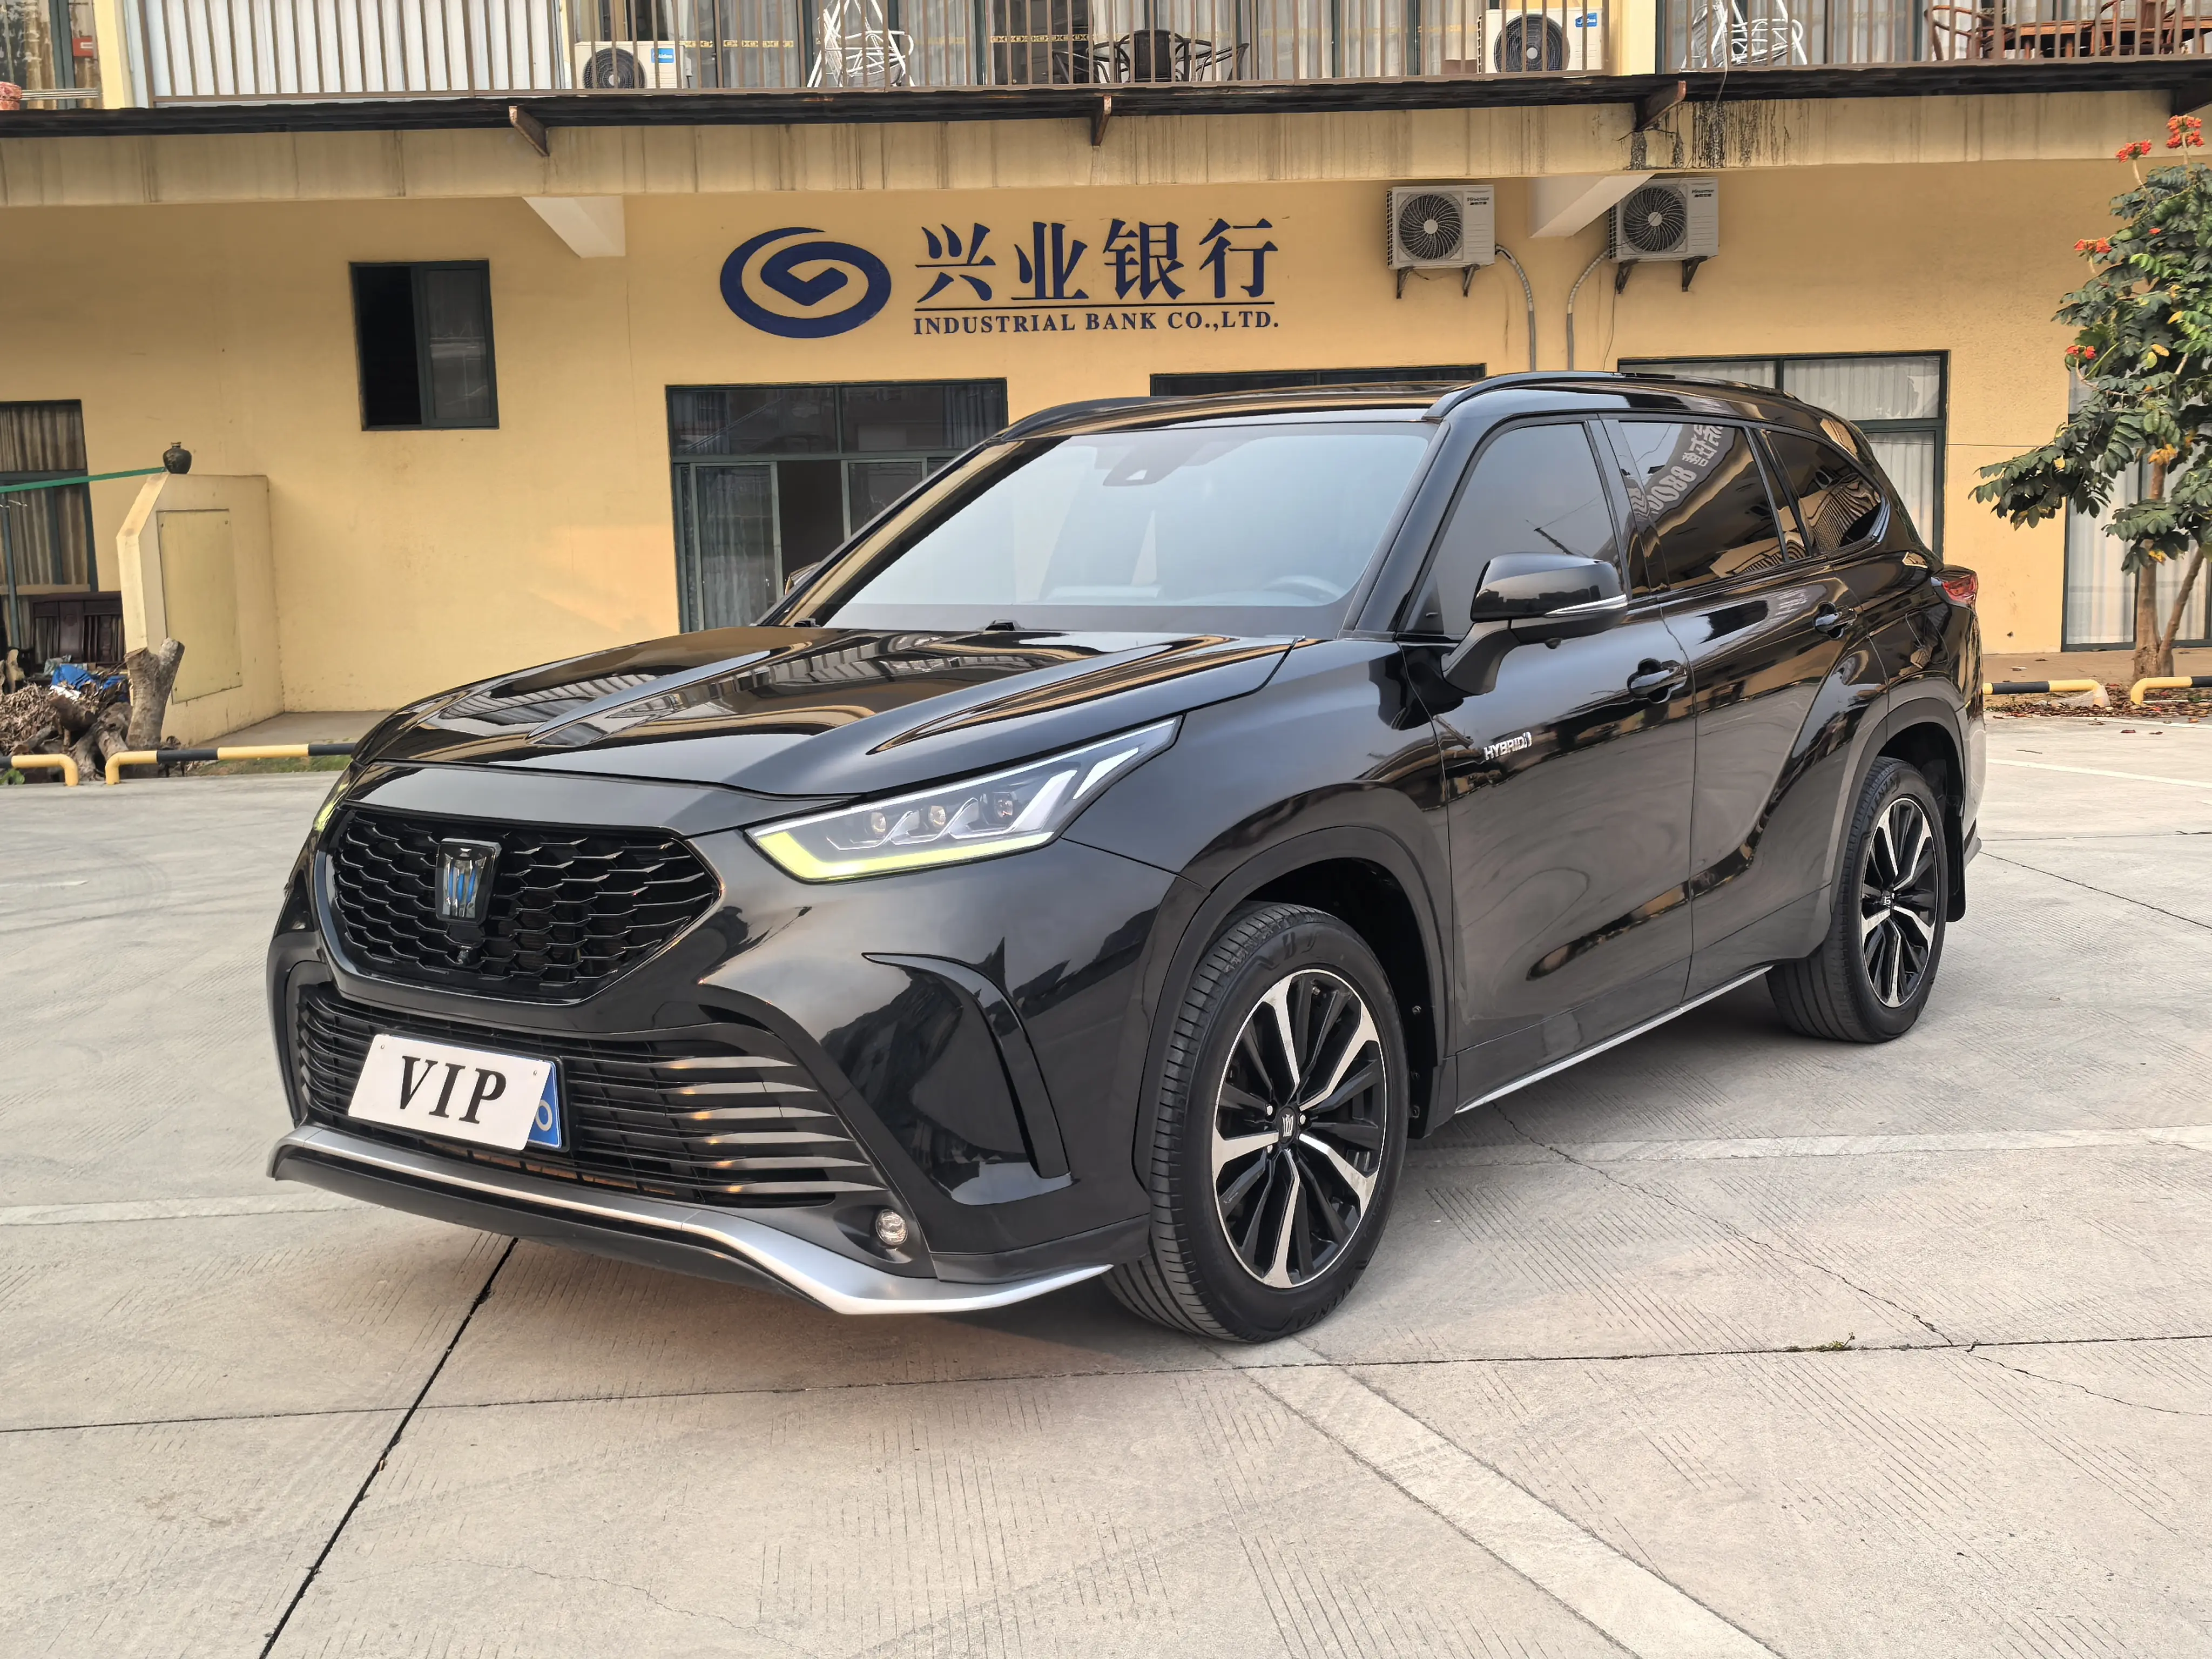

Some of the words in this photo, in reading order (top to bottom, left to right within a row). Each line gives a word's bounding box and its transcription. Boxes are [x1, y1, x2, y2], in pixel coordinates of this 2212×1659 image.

[914, 218, 1278, 302] 兴业银行
[914, 313, 1076, 335] INDUSTRIAL
[1085, 311, 1157, 331] BANK
[399, 1055, 507, 1124] VIP
